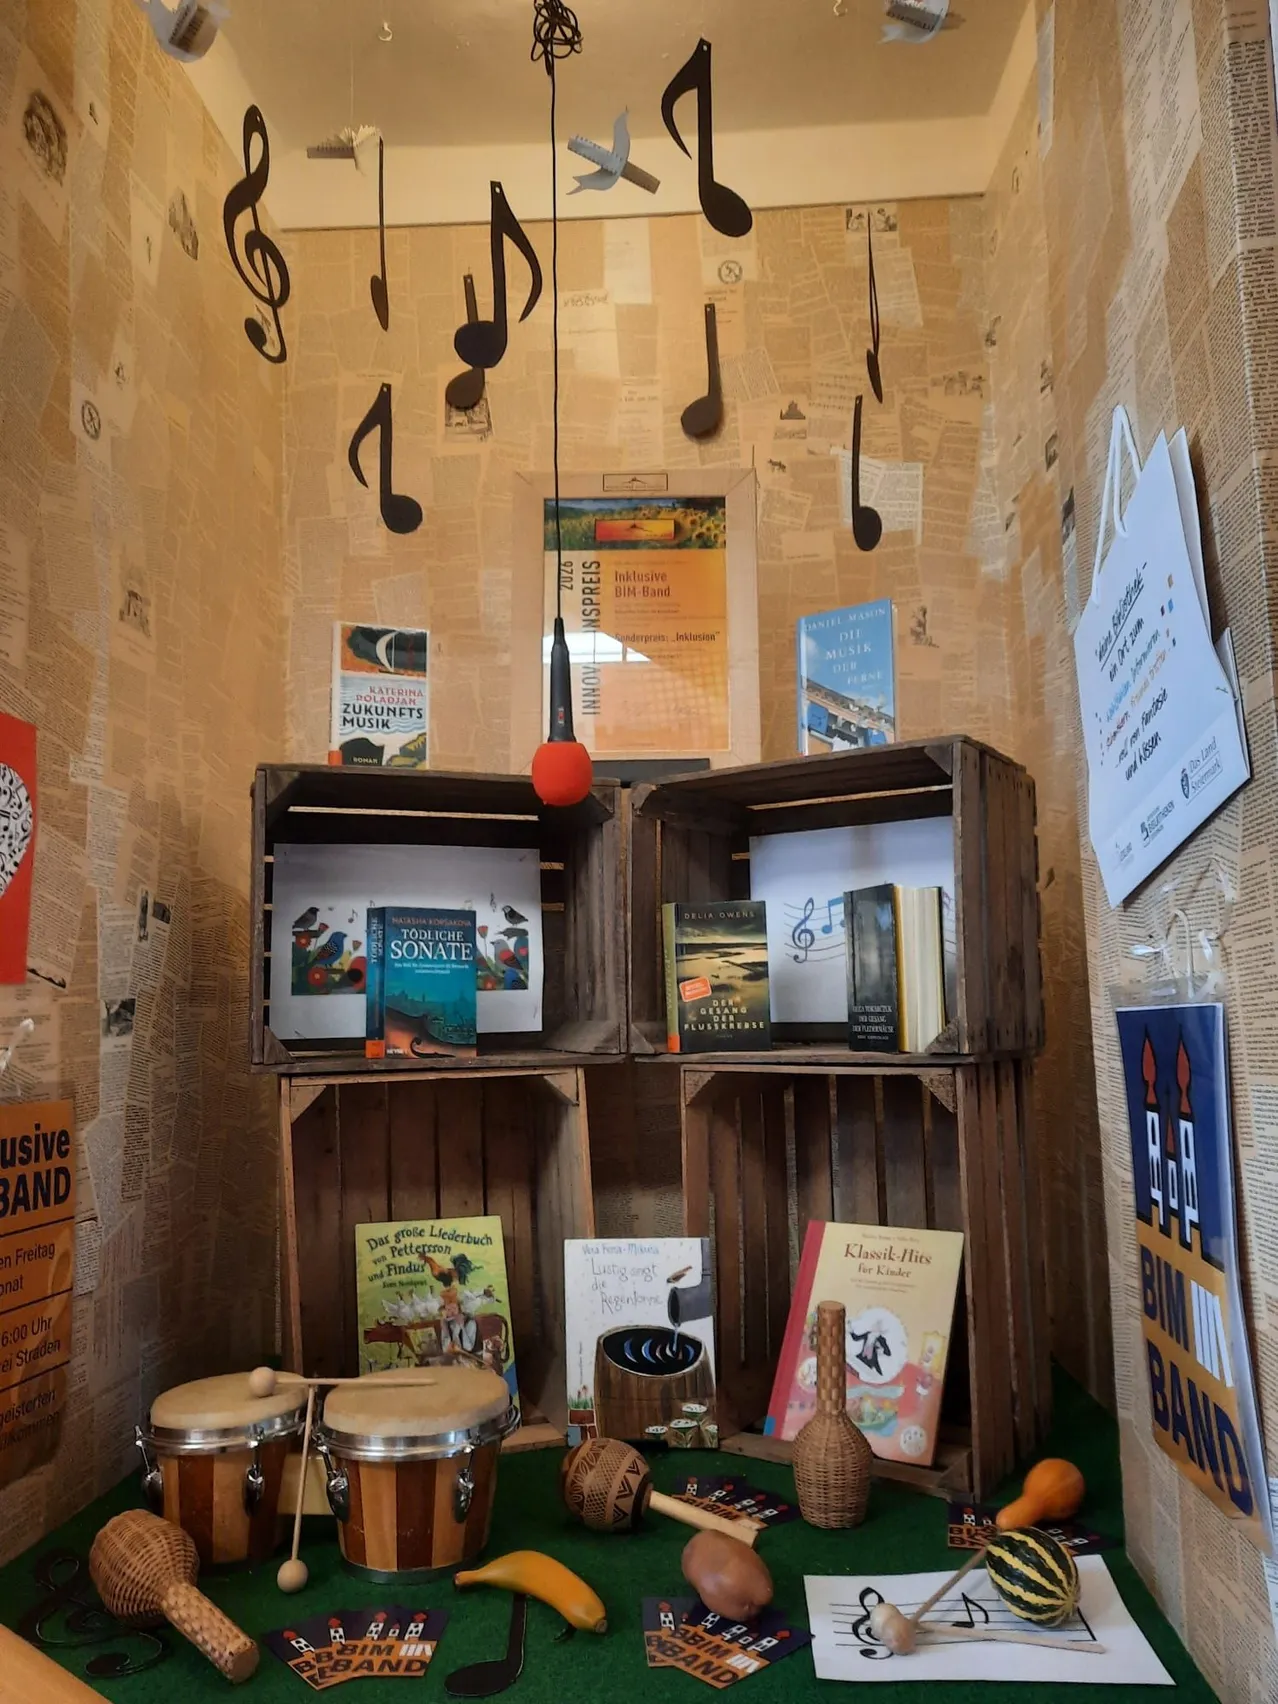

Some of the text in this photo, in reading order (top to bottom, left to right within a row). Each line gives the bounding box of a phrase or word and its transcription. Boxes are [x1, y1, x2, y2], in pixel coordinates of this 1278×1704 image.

[615, 570, 667, 583] Inklusive
[615, 586, 671, 598] BIM-Band
[804, 616, 841, 632] DANIEL
[582, 560, 601, 716] INNOVNSPREIS
[826, 643, 871, 660] MUSIK
[369, 686, 424, 697] KATERINA
[342, 703, 423, 719] ZUKUNFTS
[342, 716, 391, 729] MUSIK
[1201, 736, 1217, 762] Land
[352, 756, 378, 765] ROMAN
[401, 927, 464, 941] TÖDLICHE
[391, 940, 473, 961] SONATE
[700, 1007, 747, 1015] GESANG
[394, 1227, 426, 1244] große
[429, 1225, 493, 1246] Liederbuch
[15, 1243, 55, 1266] Freitag
[372, 1243, 452, 1265] von Pettersson
[844, 1243, 932, 1265] Klassik-Hits
[368, 1261, 426, 1282] und Findus
[591, 1257, 628, 1282] Lustig
[876, 1265, 912, 1278] Kinder
[591, 1276, 606, 1291] die
[1139, 1243, 1190, 1351] BIM
[31, 1316, 52, 1336] Uhr
[16, 1340, 60, 1367] Straden
[1147, 1338, 1254, 1517] BAND
[336, 1644, 395, 1657] BIM
